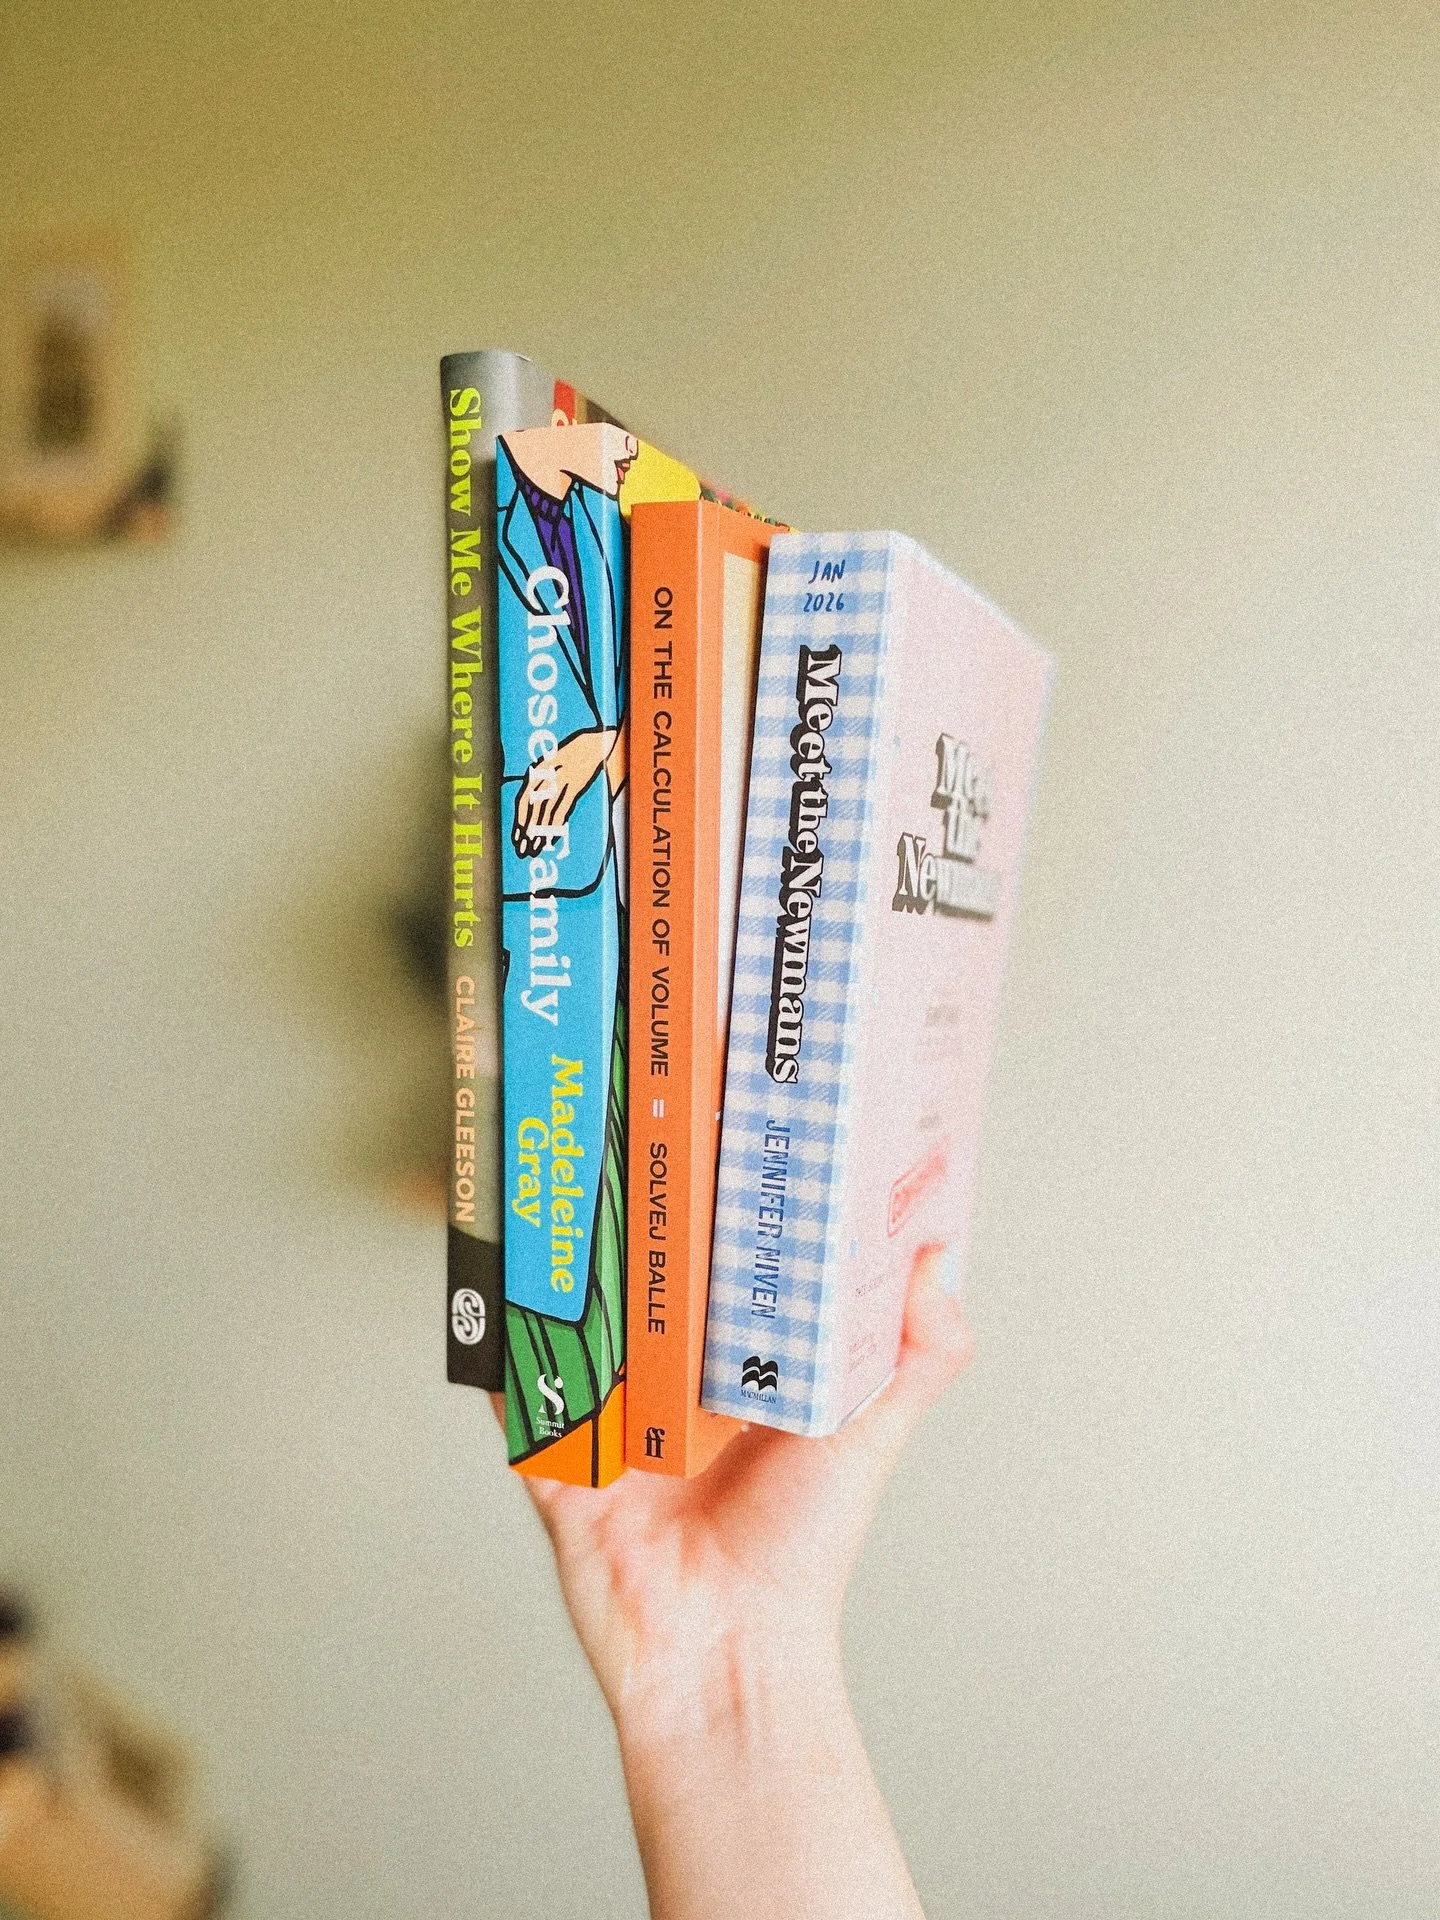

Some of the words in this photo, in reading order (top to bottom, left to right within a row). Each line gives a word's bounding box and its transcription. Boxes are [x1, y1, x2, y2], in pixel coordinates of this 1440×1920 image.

[450, 387, 482, 516] Show
[451, 527, 482, 596] Me
[654, 587, 673, 629] ON
[803, 592, 845, 612] 2026
[808, 559, 846, 584] JAN
[452, 606, 483, 763] Where
[526, 565, 571, 804] Chosen
[653, 641, 672, 699] THE
[790, 644, 842, 782] Meet
[453, 774, 484, 811] It
[652, 711, 672, 908] CALCULATION
[789, 781, 828, 855] the
[453, 820, 484, 947] Hurts
[521, 821, 572, 1026] Family
[651, 919, 670, 956] OF
[766, 846, 825, 1085] Newmans
[455, 975, 476, 1079] CLAIRE
[650, 966, 670, 1077] VOLUME
[454, 1087, 475, 1223] GLEESON
[512, 1117, 549, 1228] Gray
[550, 1053, 584, 1293] Madeleine
[649, 1142, 668, 1240] SOLVEJ
[758, 1119, 791, 1239] JENNIFER
[647, 1250, 667, 1335] BALLE
[751, 1246, 782, 1320] NIVEN
[535, 1417, 565, 1429] Summit
[539, 1427, 563, 1438] Books
